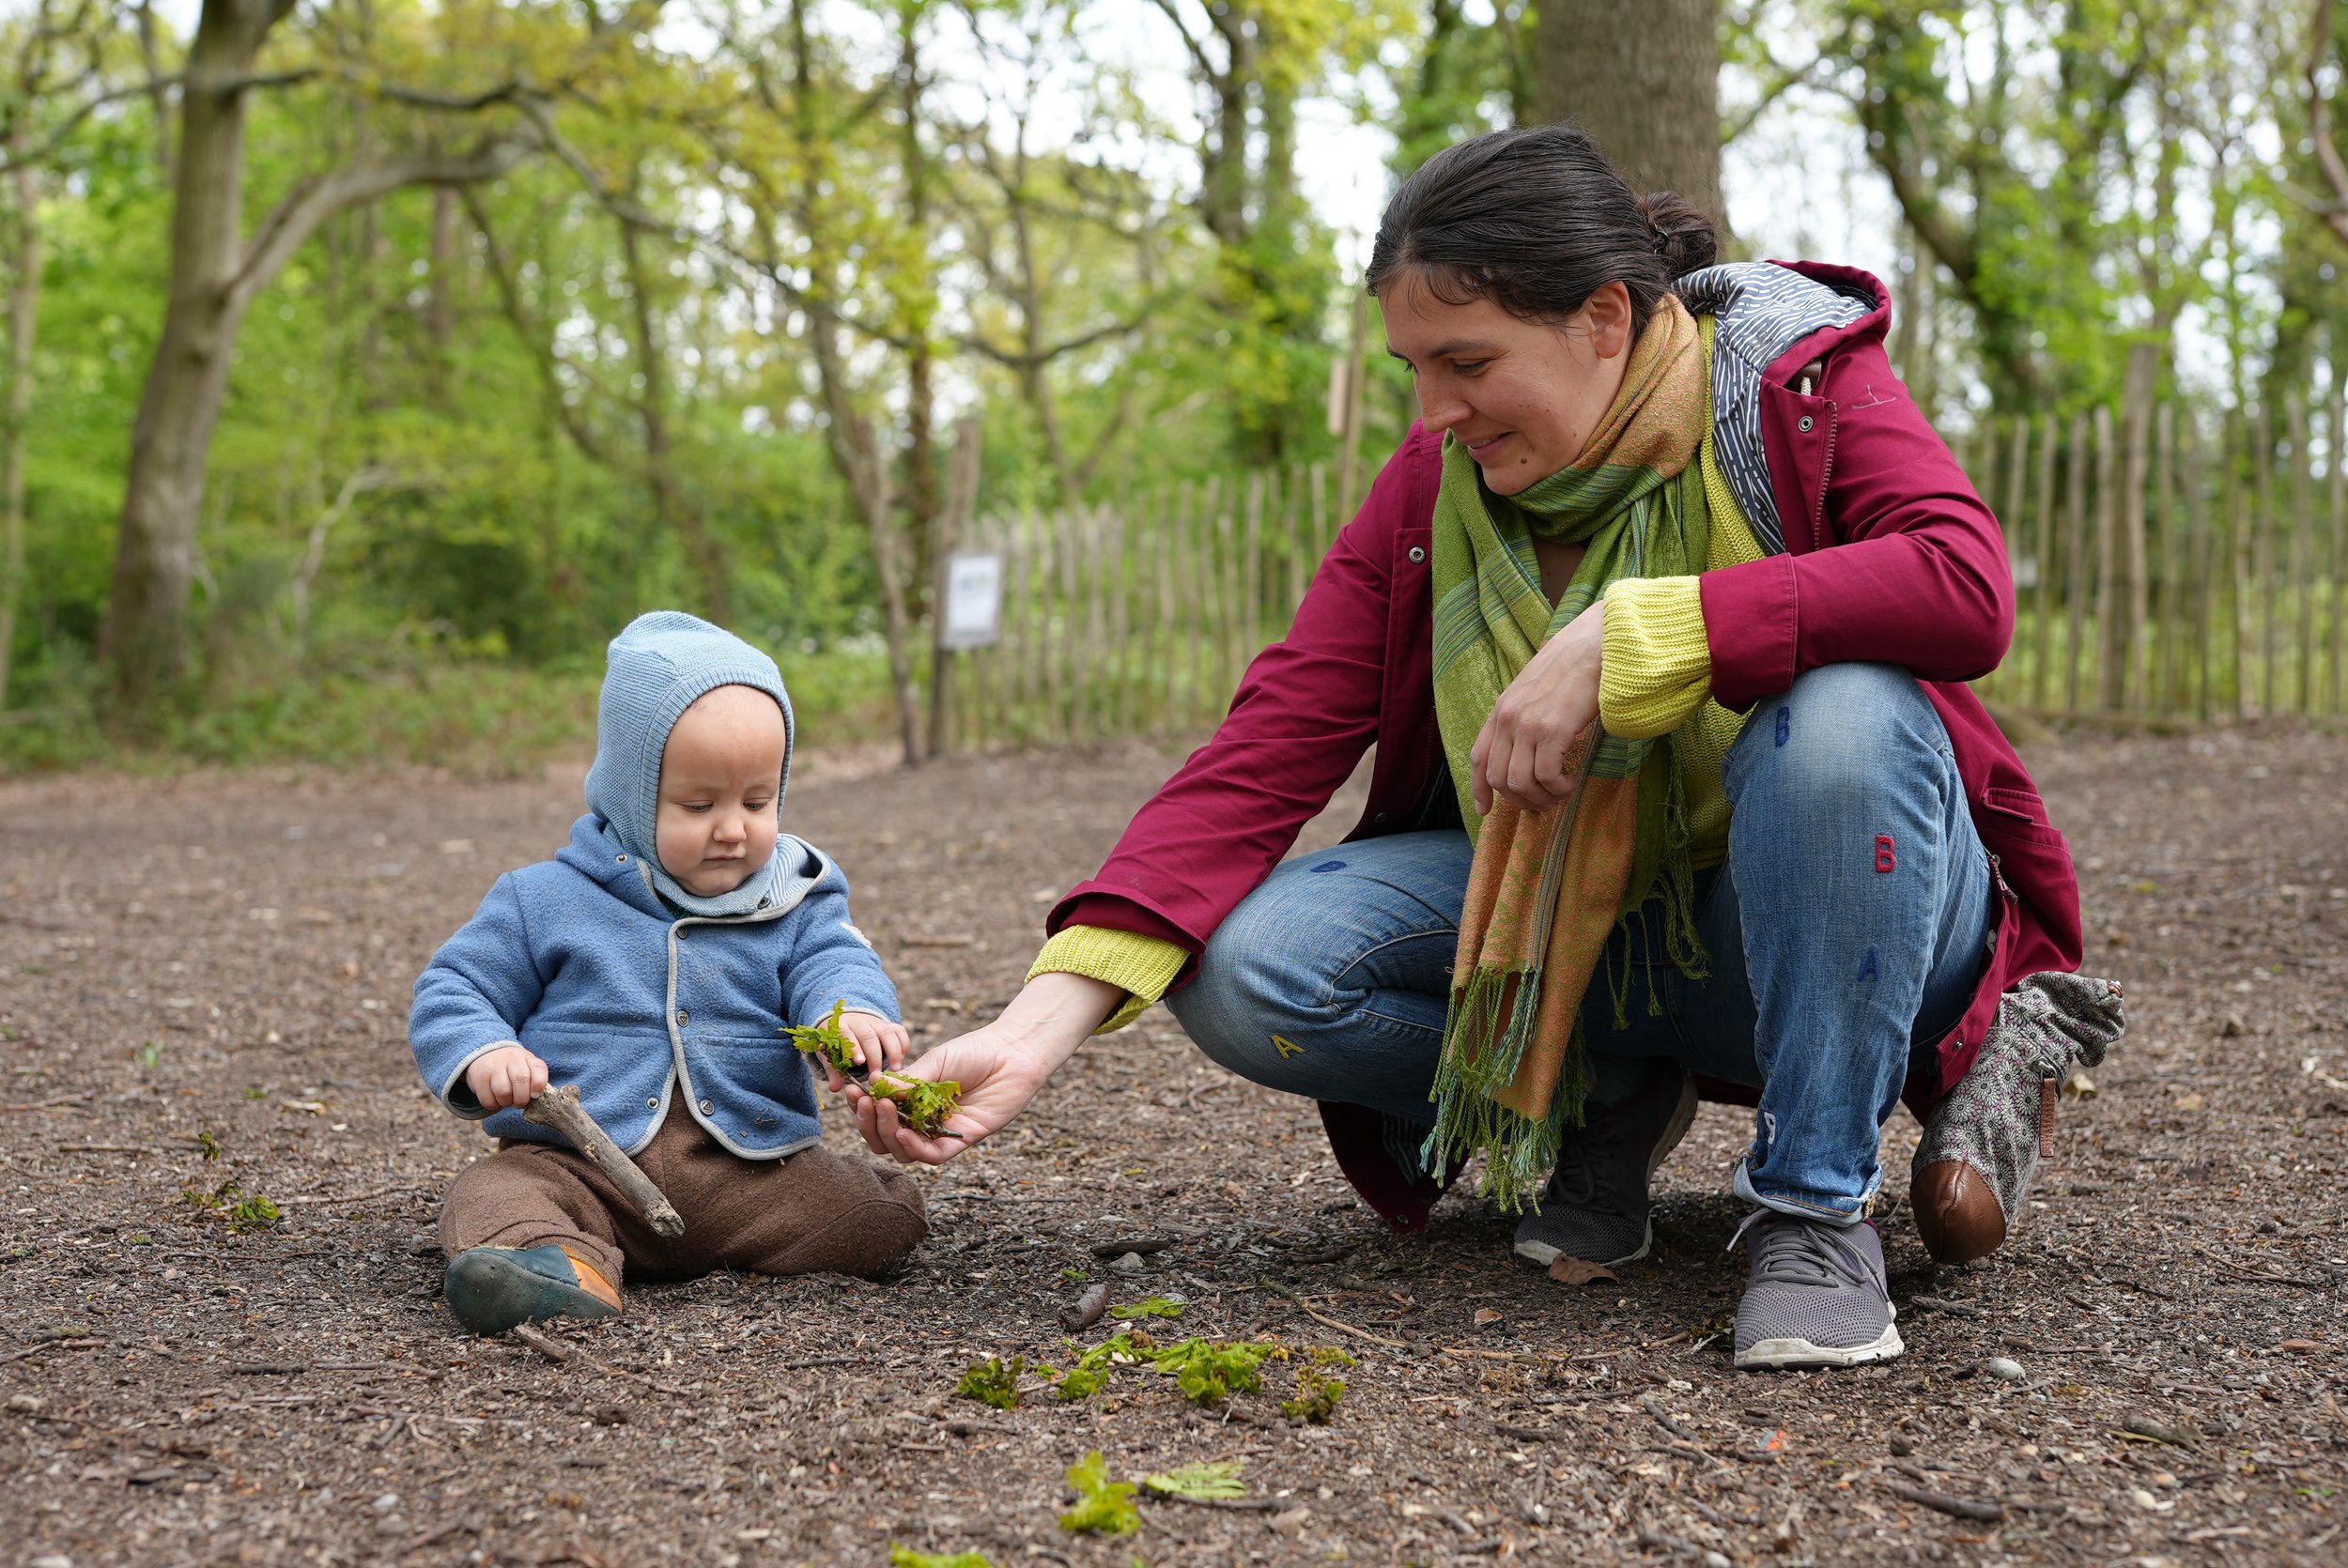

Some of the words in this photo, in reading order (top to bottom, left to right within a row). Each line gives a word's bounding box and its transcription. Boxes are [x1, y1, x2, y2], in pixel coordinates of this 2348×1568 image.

[1775, 706, 1790, 748] B
[1875, 834, 1896, 873] B
[1857, 945, 1880, 982] A
[1271, 1034, 1305, 1059] A
